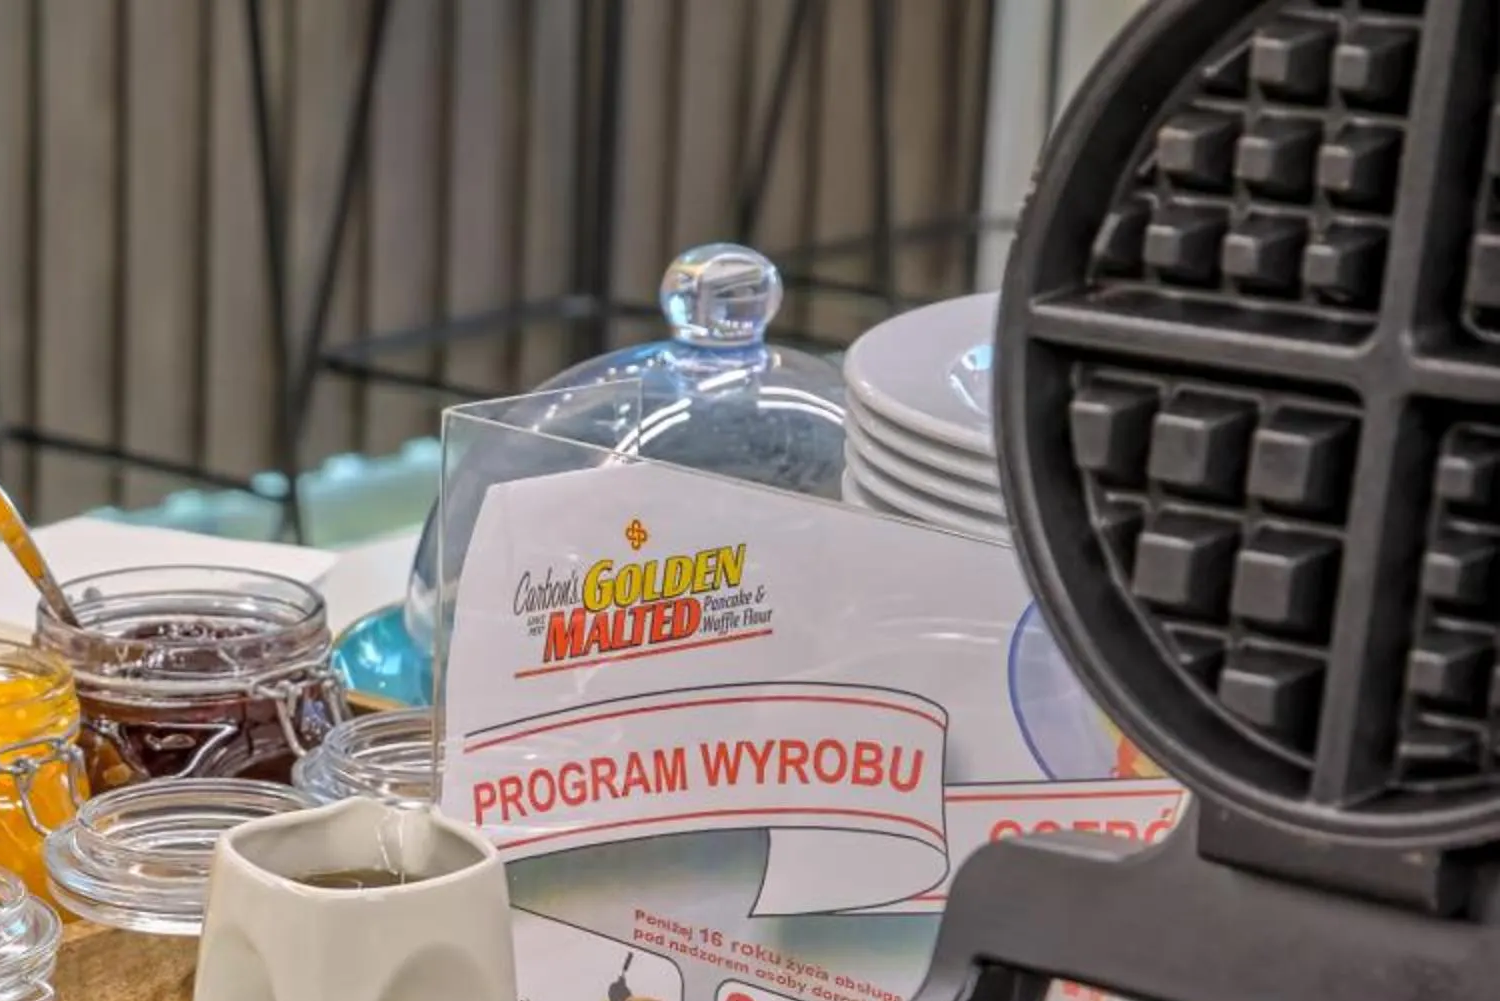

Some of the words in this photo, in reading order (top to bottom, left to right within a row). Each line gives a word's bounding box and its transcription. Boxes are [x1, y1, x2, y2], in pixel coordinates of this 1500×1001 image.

[581, 543, 747, 613] GOLDEN
[754, 584, 767, 604] &
[542, 597, 703, 663] MALTED
[473, 746, 689, 827] PROGRAM
[699, 738, 925, 794] WYROBU
[632, 926, 666, 946] pod
[668, 940, 750, 976] nadzorem
[754, 967, 808, 994] osoby
[698, 927, 724, 949] 16
[730, 939, 782, 965] roku
